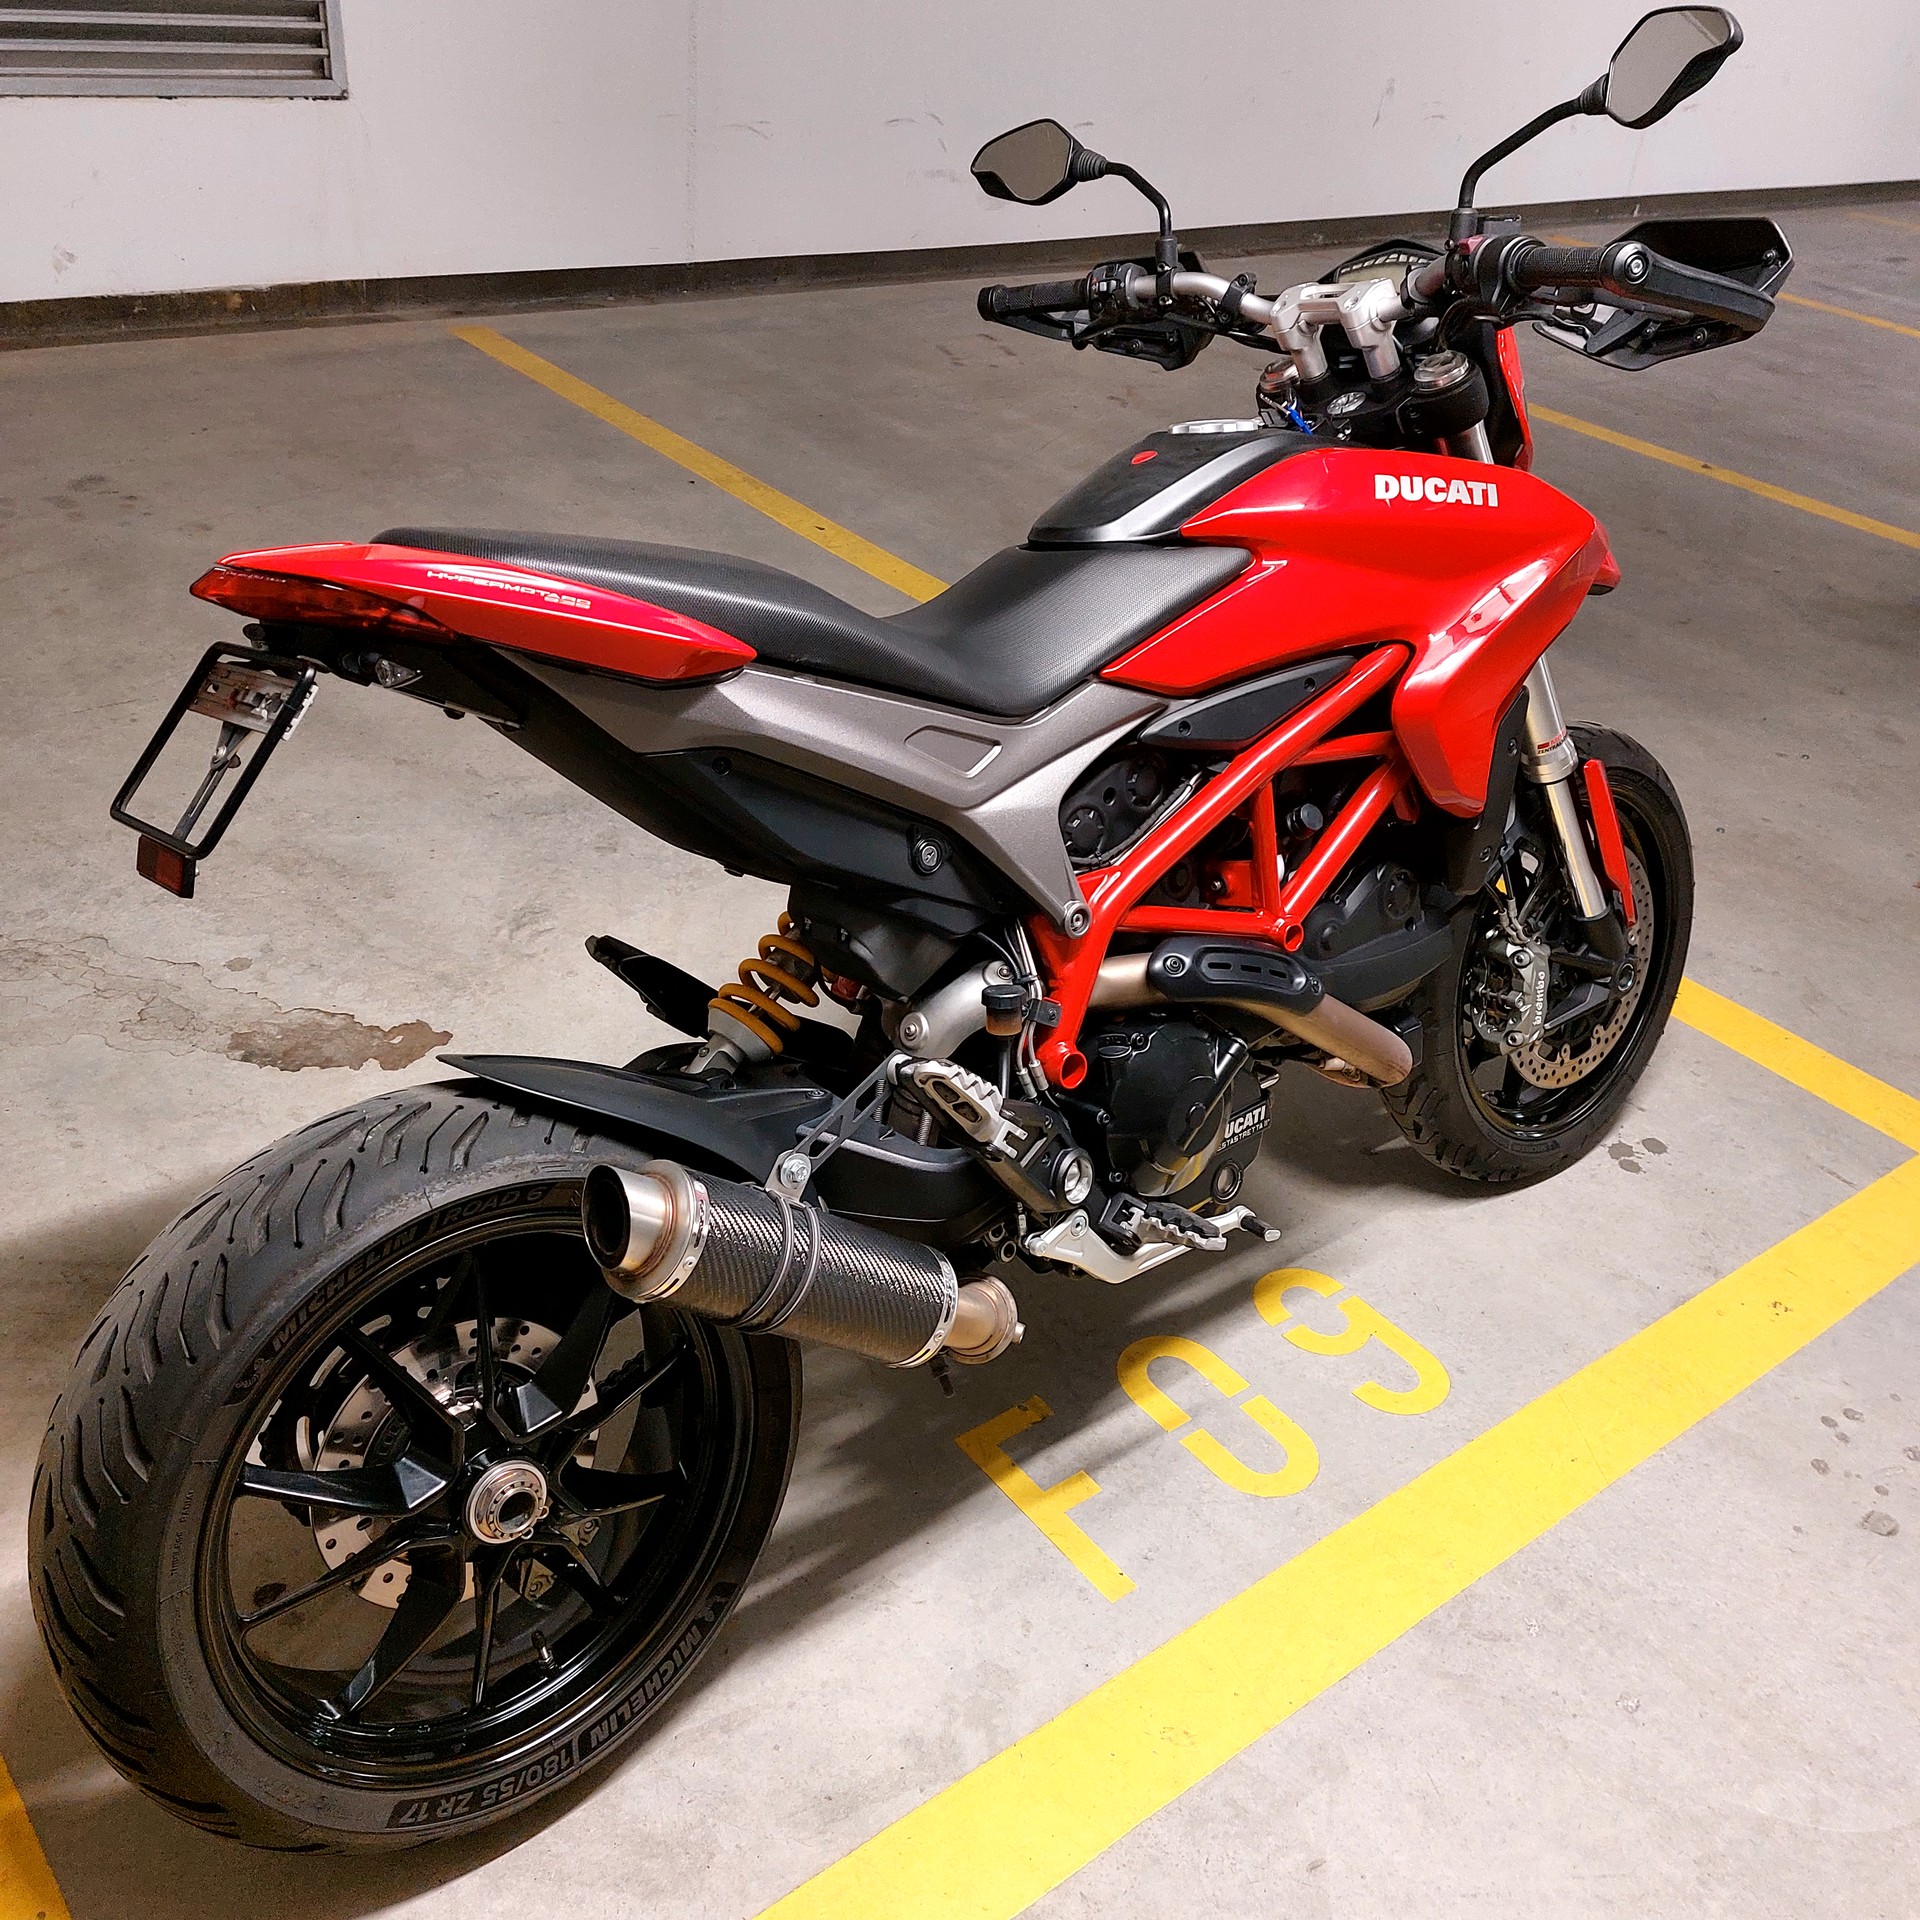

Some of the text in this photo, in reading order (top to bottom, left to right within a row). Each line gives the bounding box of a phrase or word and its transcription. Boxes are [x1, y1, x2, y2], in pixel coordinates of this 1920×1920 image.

[1374, 474, 1498, 507] DUCATI
[1532, 971, 1546, 1026] brembo
[1224, 1104, 1266, 1139] UCATI
[271, 1186, 549, 1351] MICHELIN ROAD 6
[590, 1625, 703, 1749] MICHELIN
[481, 1748, 571, 1806] 180/55
[401, 1801, 430, 1824] 17
[438, 1791, 471, 1819] ZR
